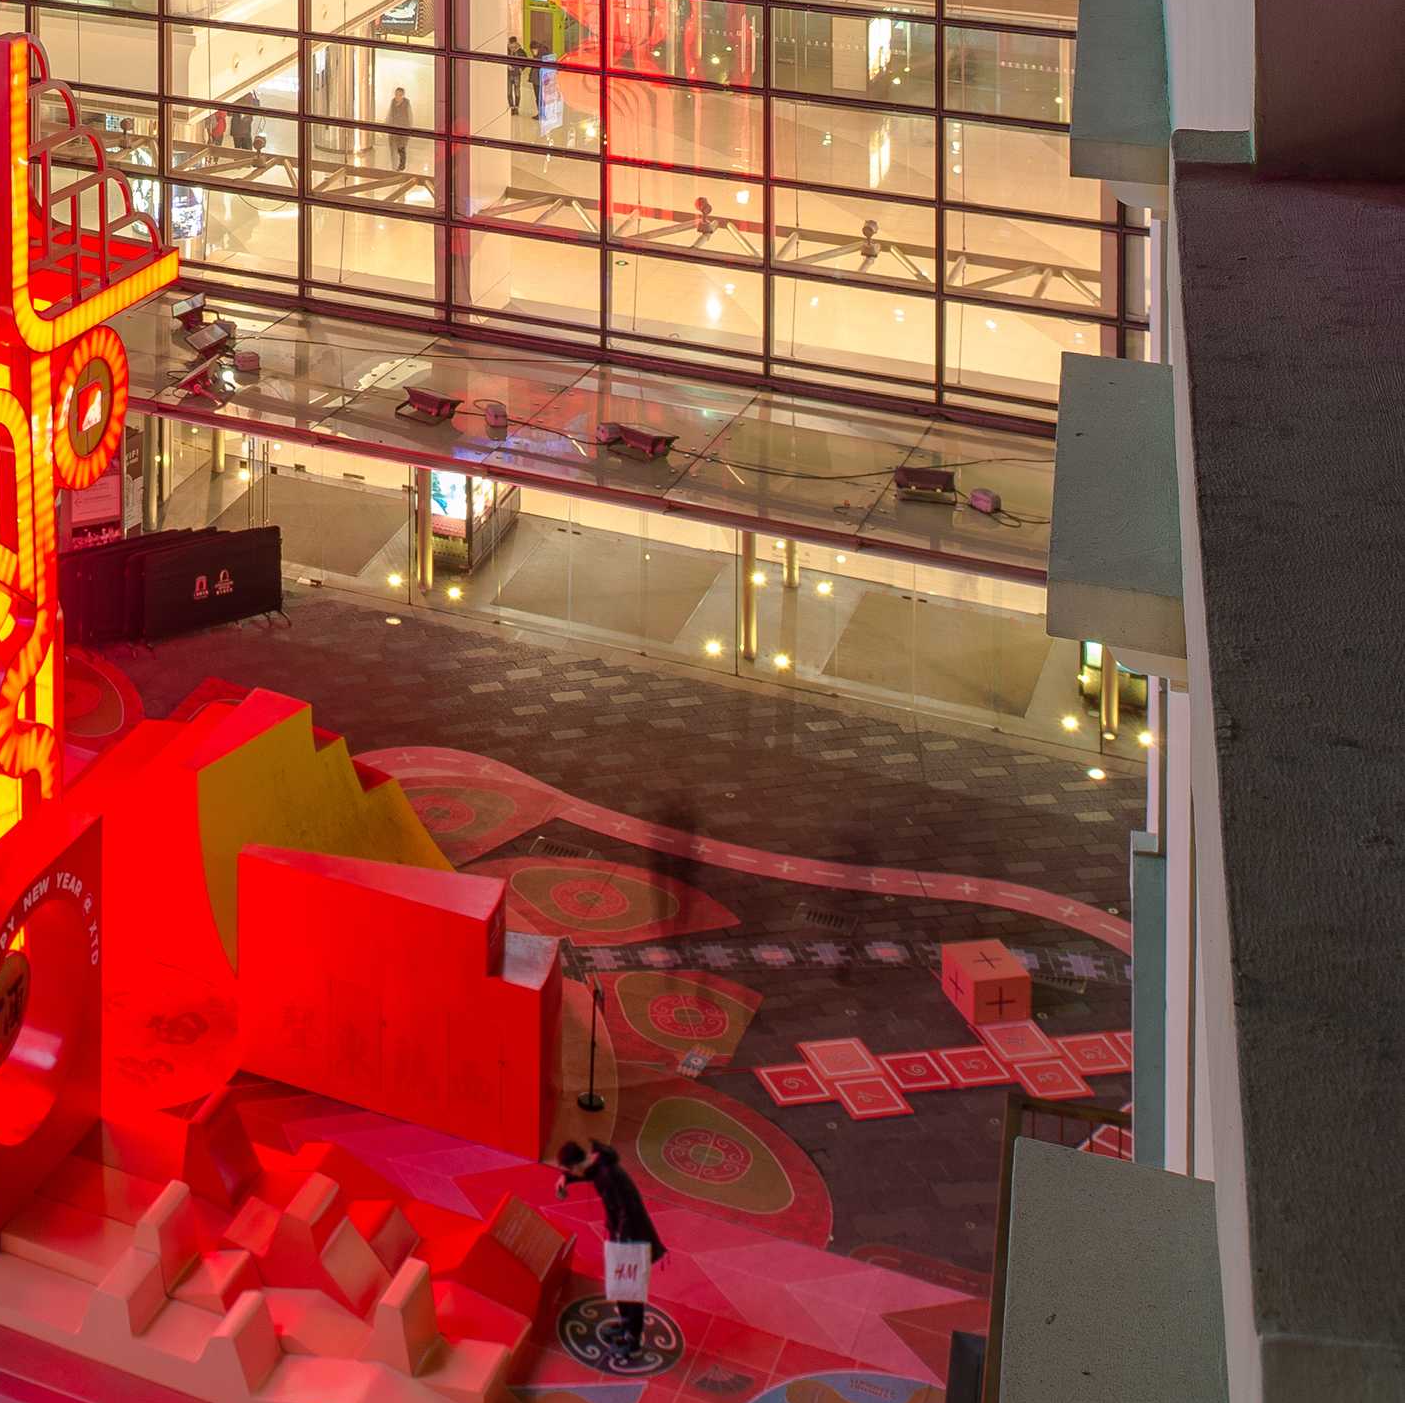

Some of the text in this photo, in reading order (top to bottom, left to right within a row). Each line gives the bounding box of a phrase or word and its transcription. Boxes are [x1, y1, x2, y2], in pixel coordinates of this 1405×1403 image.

[23, 876, 51, 912] NEW
[56, 872, 83, 897] YEAR
[88, 918, 99, 965] XTD
